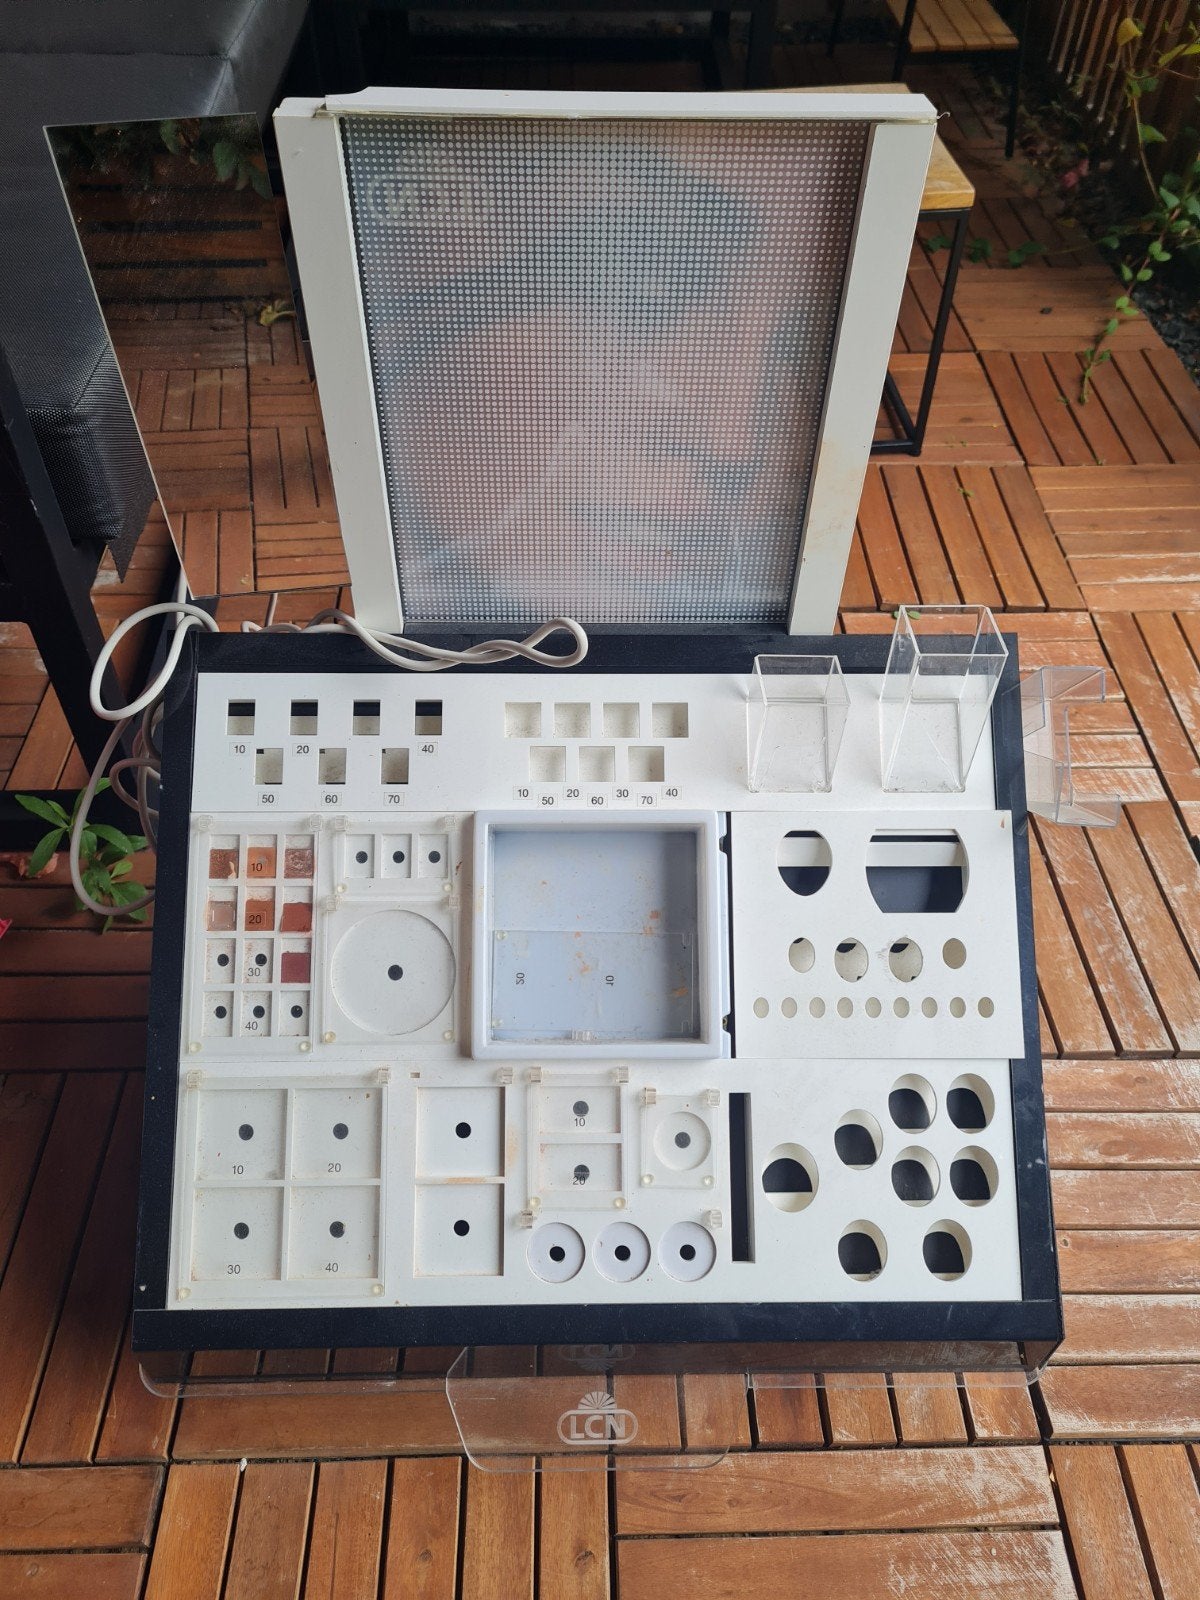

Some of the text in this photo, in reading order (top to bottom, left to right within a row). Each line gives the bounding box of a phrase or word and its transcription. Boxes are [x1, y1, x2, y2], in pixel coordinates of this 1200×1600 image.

[234, 744, 246, 754] 10
[296, 744, 310, 754] 20
[421, 744, 434, 754] 40
[517, 788, 529, 798] 10
[566, 788, 580, 798] 20
[616, 788, 629, 798] 30
[665, 788, 678, 798] 40
[261, 793, 275, 804] 50
[324, 794, 338, 804] 60
[388, 794, 401, 804] 70
[541, 796, 554, 806] 50
[591, 796, 604, 806] 60
[641, 795, 653, 805] 70
[251, 863, 263, 872] 10
[248, 914, 262, 925] 20
[247, 967, 261, 977] 30
[245, 1021, 258, 1031] 40
[574, 1117, 586, 1127] 10
[232, 1164, 244, 1175] 10
[327, 1163, 342, 1173] 20
[572, 1175, 587, 1186] 20
[227, 1264, 241, 1275] 30
[325, 1262, 339, 1273] 40
[570, 1414, 626, 1439] LCN
